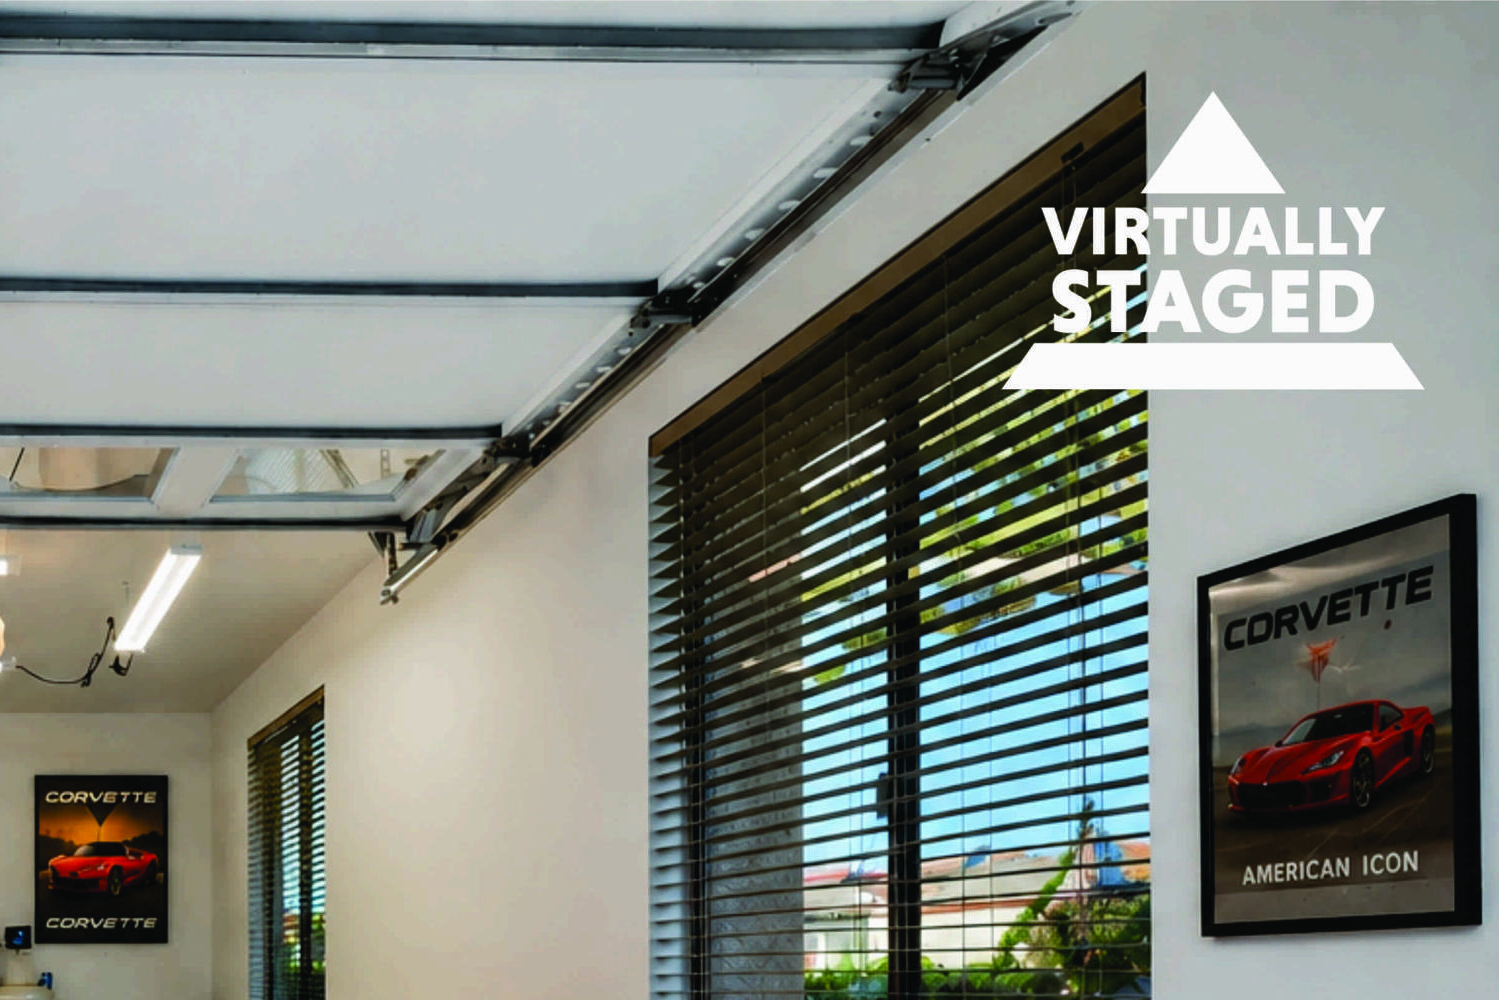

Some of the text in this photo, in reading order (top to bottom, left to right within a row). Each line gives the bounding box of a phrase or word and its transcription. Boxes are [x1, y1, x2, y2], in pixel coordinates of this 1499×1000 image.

[1224, 566, 1434, 651] CORVETTE
[45, 791, 157, 803] CORVETTE
[1243, 851, 1419, 885] AMERICAN ICON
[46, 917, 157, 928] CORVETTE
